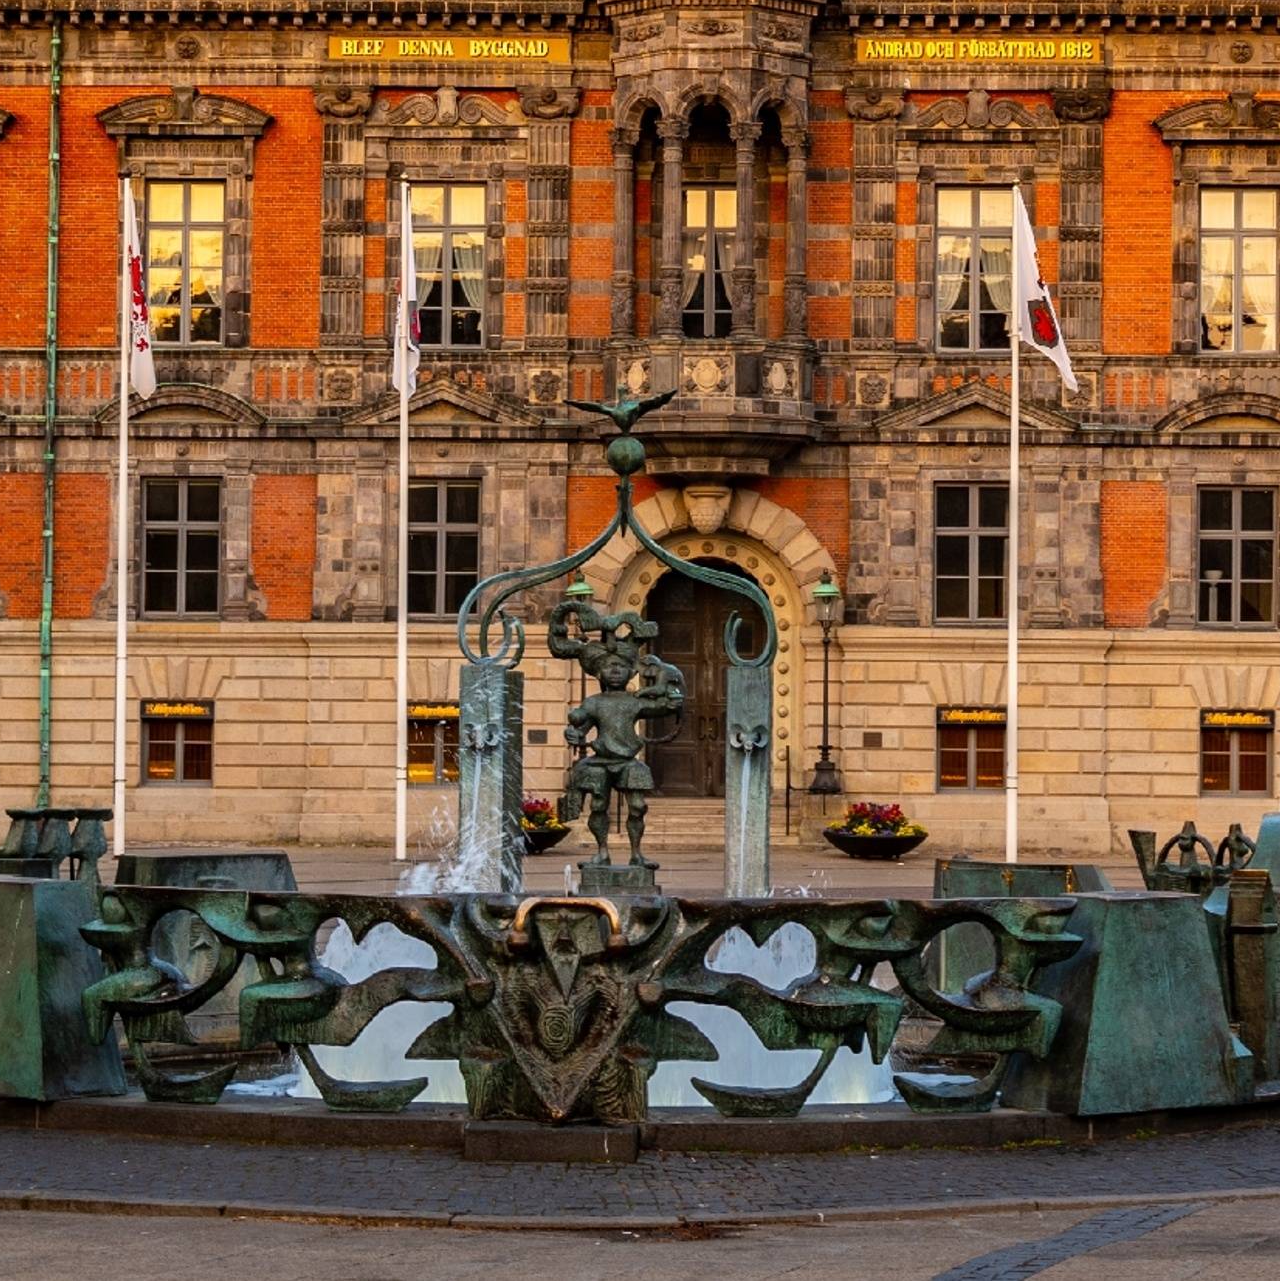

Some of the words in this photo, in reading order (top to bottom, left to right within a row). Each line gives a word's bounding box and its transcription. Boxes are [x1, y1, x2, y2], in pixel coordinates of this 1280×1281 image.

[341, 39, 385, 56] BLEF
[398, 39, 454, 56] DENNA
[469, 39, 549, 57] BYGGNAD
[865, 39, 924, 58] ÄNDRAD
[926, 41, 954, 58] OCH
[958, 38, 1056, 58] FÖRBÄTTRAD
[1060, 40, 1094, 58] 1812
